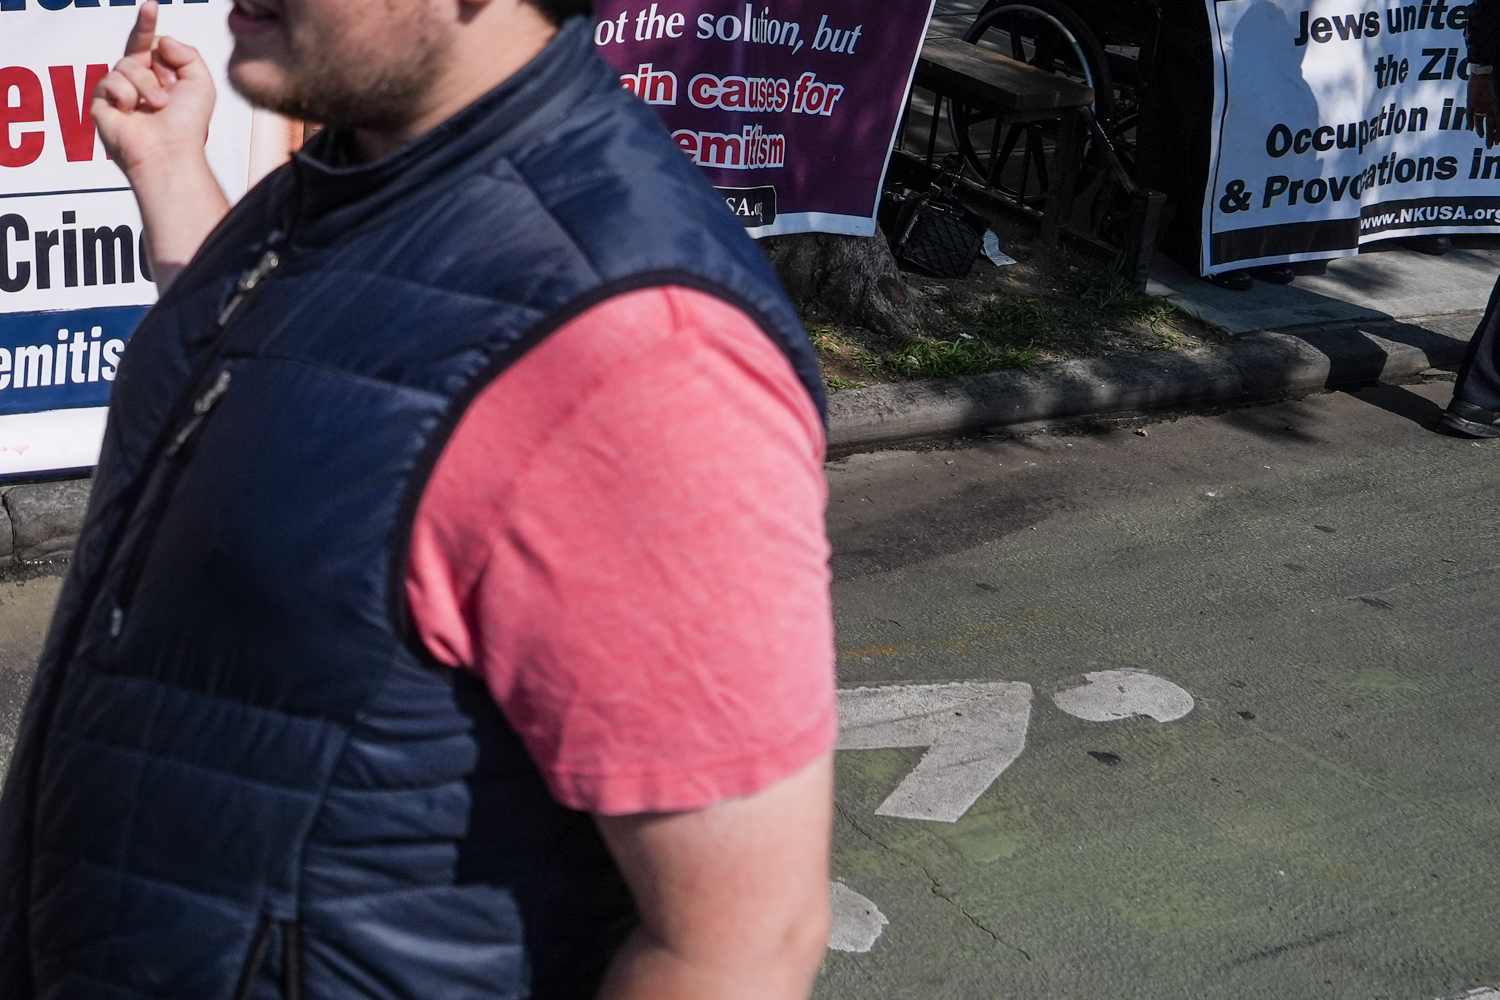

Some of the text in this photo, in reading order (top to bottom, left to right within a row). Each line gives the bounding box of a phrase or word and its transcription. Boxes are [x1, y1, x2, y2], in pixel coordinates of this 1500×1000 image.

[594, 3, 862, 56] ot the solution, but
[1294, 7, 1380, 47] Jews
[619, 62, 844, 117] ain causes for
[1375, 54, 1409, 90] the
[1265, 102, 1428, 158] Occupation
[1219, 178, 1252, 215] &
[1360, 205, 1500, 230] www.NKUSA.org
